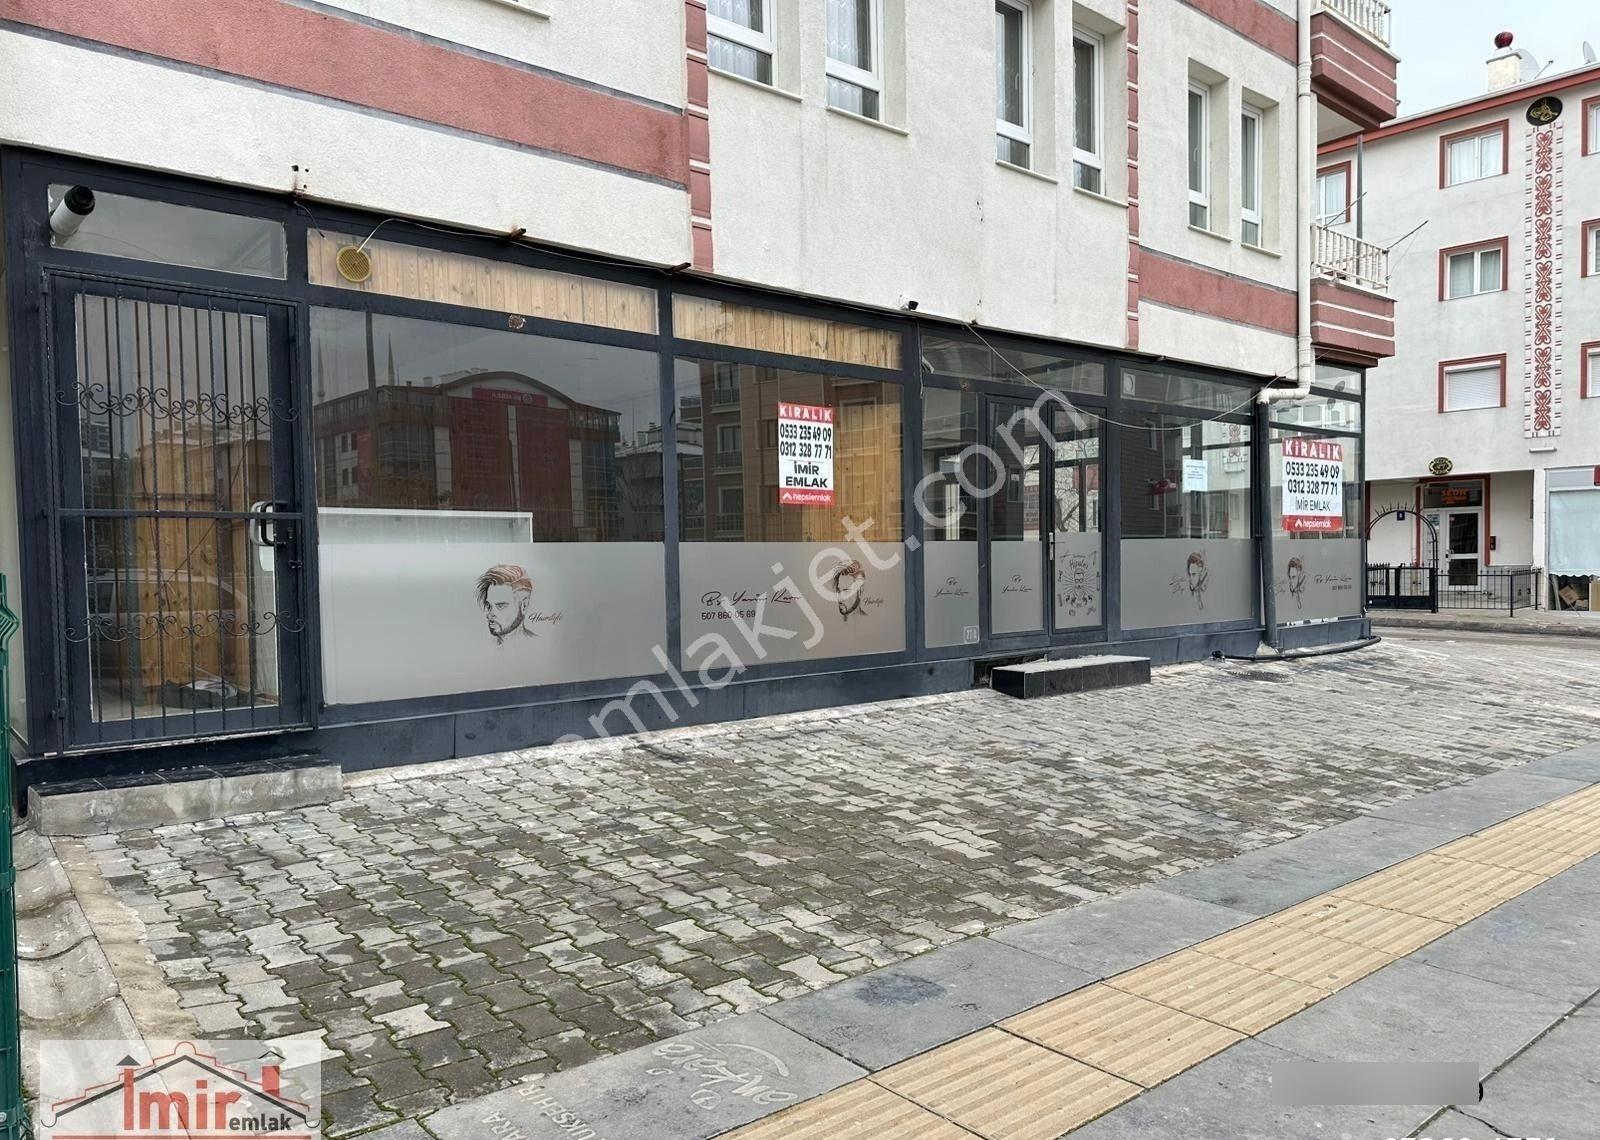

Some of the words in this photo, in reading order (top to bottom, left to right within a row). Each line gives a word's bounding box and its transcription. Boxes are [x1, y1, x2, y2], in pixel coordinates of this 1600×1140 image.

[780, 405, 832, 421] KIRALIK
[780, 423, 797, 440] 0533
[799, 425, 811, 440] 235
[813, 427, 821, 442] 49
[823, 427, 832, 442] 09
[780, 441, 796, 456] 0312
[799, 442, 812, 458] 328
[814, 444, 822, 458] 77
[825, 445, 832, 459] 71
[793, 461, 820, 475] İMİR
[1285, 461, 1304, 476] 0533
[1305, 462, 1319, 477] 235
[1320, 464, 1329, 478] 49
[1330, 465, 1340, 479] 09
[785, 476, 828, 488] EMLAK
[1287, 479, 1305, 493] 0312
[1306, 480, 1319, 494] 328
[1321, 481, 1329, 495] 77
[1331, 482, 1338, 495] 71
[793, 492, 832, 502] hepsiemlak
[1309, 500, 1331, 511] EMLAK
[1302, 519, 1331, 529] hepsiemlak
[701, 612, 716, 620] 507
